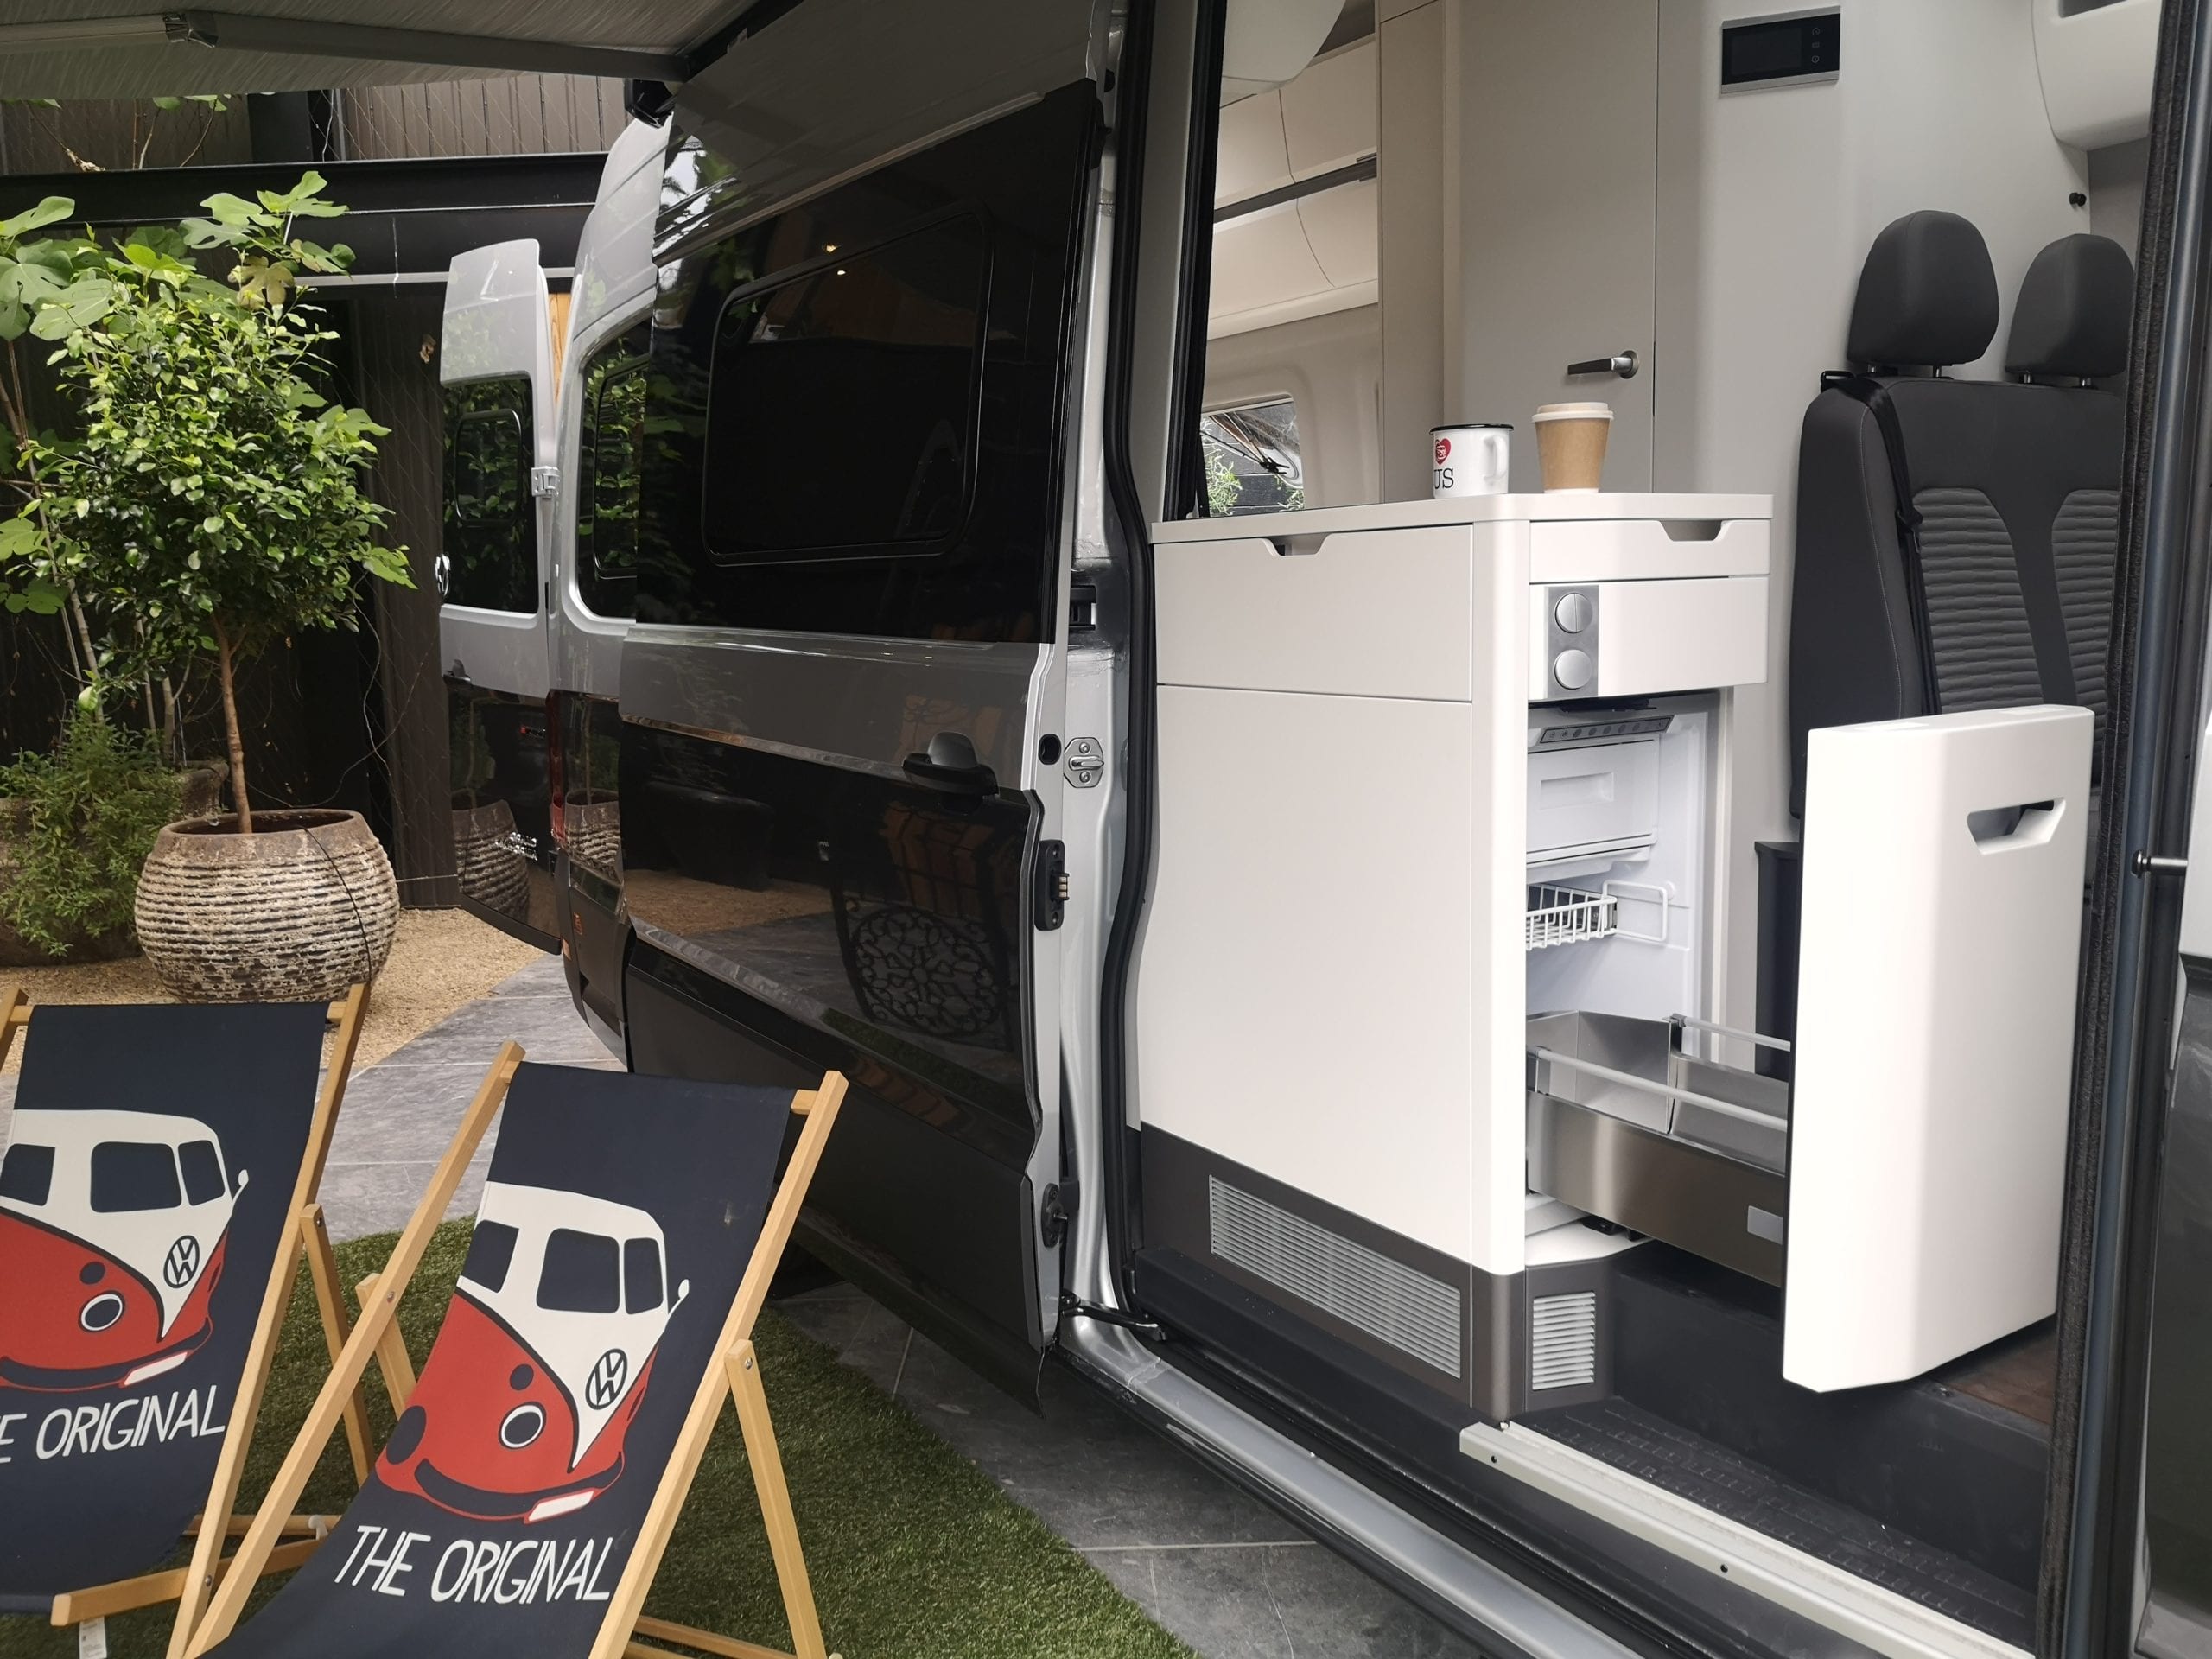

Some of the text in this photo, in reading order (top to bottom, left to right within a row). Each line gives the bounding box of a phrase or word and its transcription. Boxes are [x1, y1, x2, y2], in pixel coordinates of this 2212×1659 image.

[35, 1384, 226, 1460] ORIGINAL
[334, 1525, 613, 1605] THE ORIGINAL
